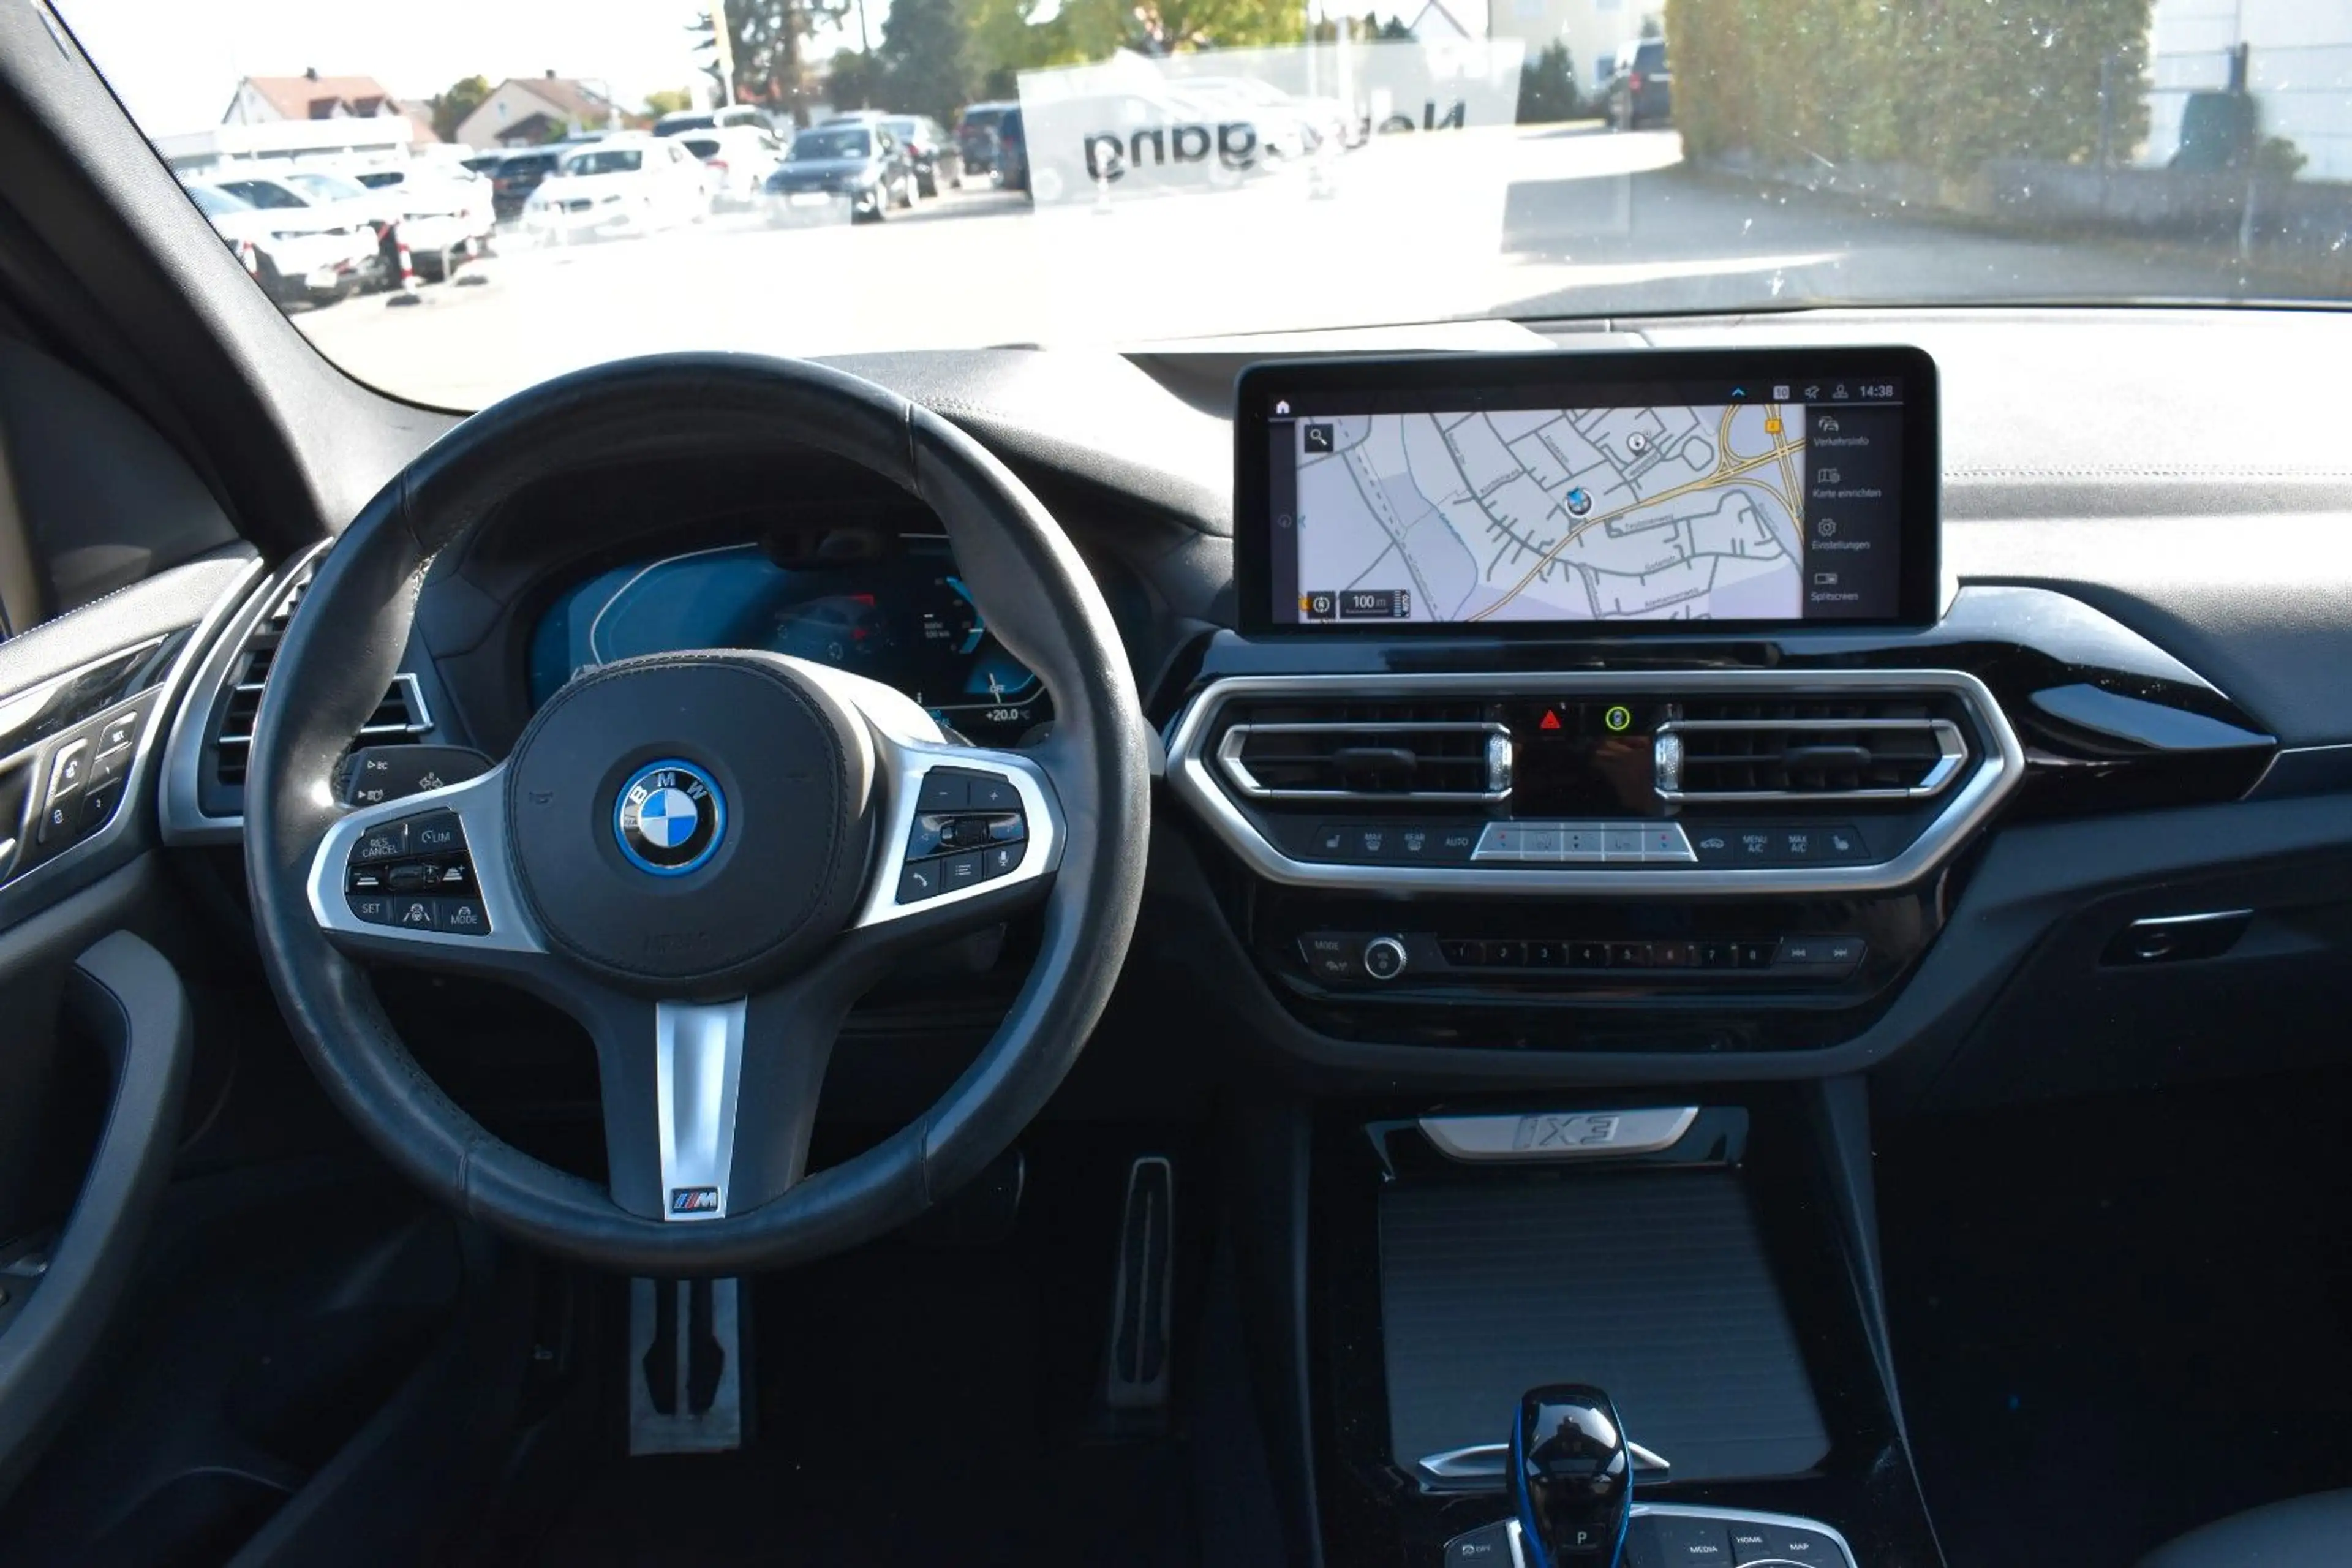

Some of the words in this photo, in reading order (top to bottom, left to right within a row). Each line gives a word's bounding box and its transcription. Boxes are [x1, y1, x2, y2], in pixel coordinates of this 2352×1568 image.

[1860, 385, 1893, 398] 14:38
[1812, 540, 1871, 552] Einstellungen
[1354, 594, 1375, 608] 100
[986, 708, 1019, 722] +20.0
[630, 772, 708, 804] BMW
[433, 832, 451, 843] LIM
[1446, 837, 1469, 847] AUTO
[1743, 835, 1768, 844] MENU
[1789, 835, 1807, 844] MAX
[363, 845, 399, 858] CANCEL
[1748, 843, 1763, 853] A/C
[362, 903, 380, 914] SET
[451, 913, 478, 925] MODE
[1314, 940, 1339, 951] MODE
[1577, 1531, 1587, 1545] P
